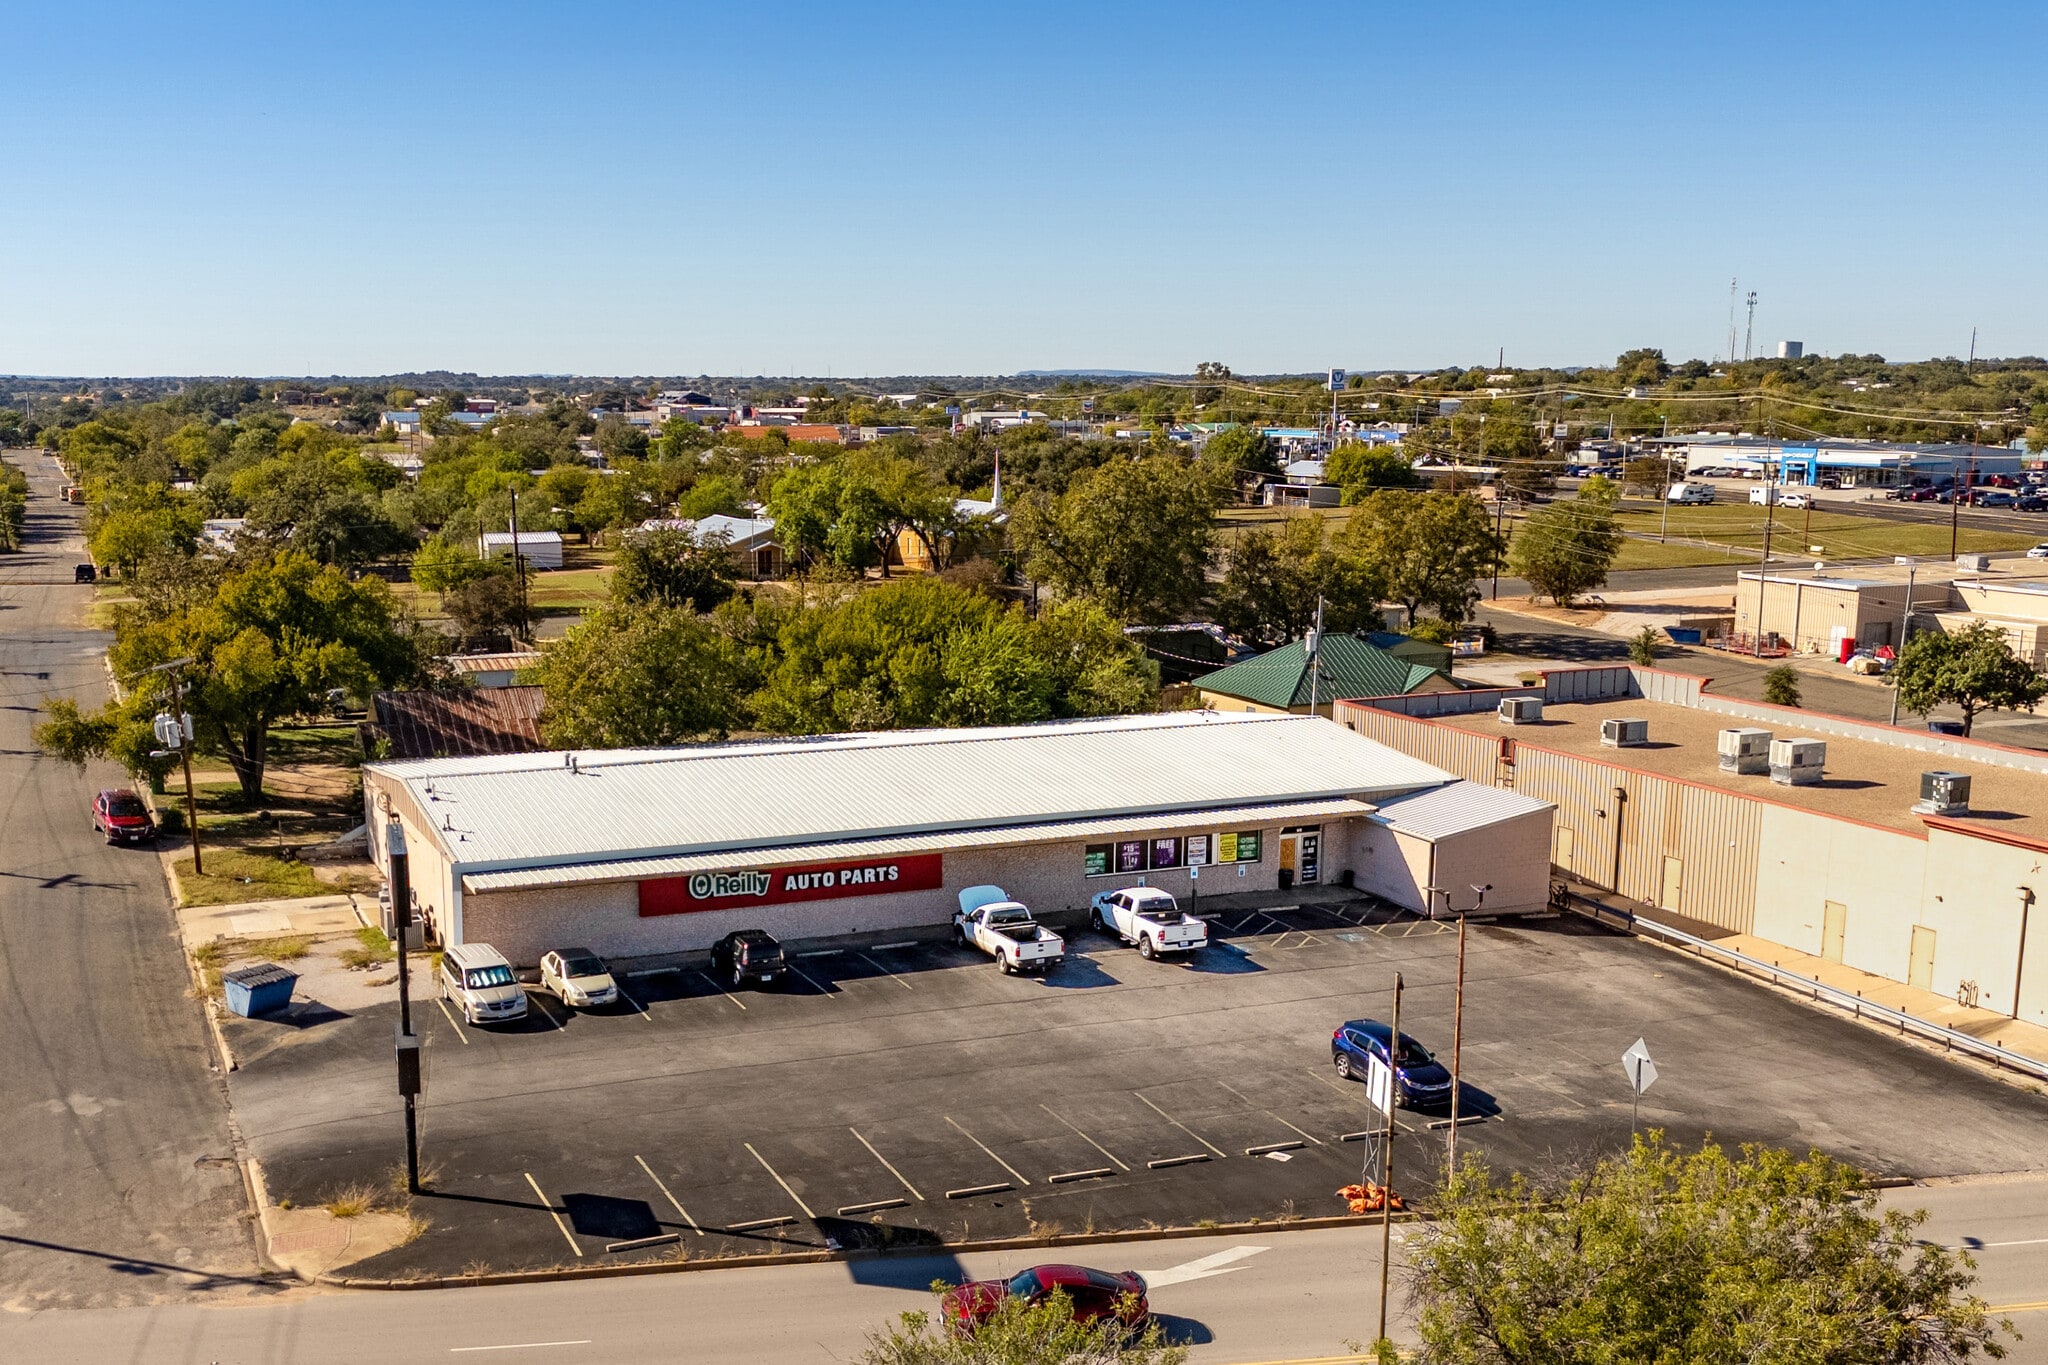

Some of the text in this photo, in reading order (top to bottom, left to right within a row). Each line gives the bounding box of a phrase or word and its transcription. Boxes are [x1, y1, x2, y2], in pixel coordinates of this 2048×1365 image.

[689, 871, 772, 900] O'Reilly
[785, 865, 899, 891] AUTO PARTS
